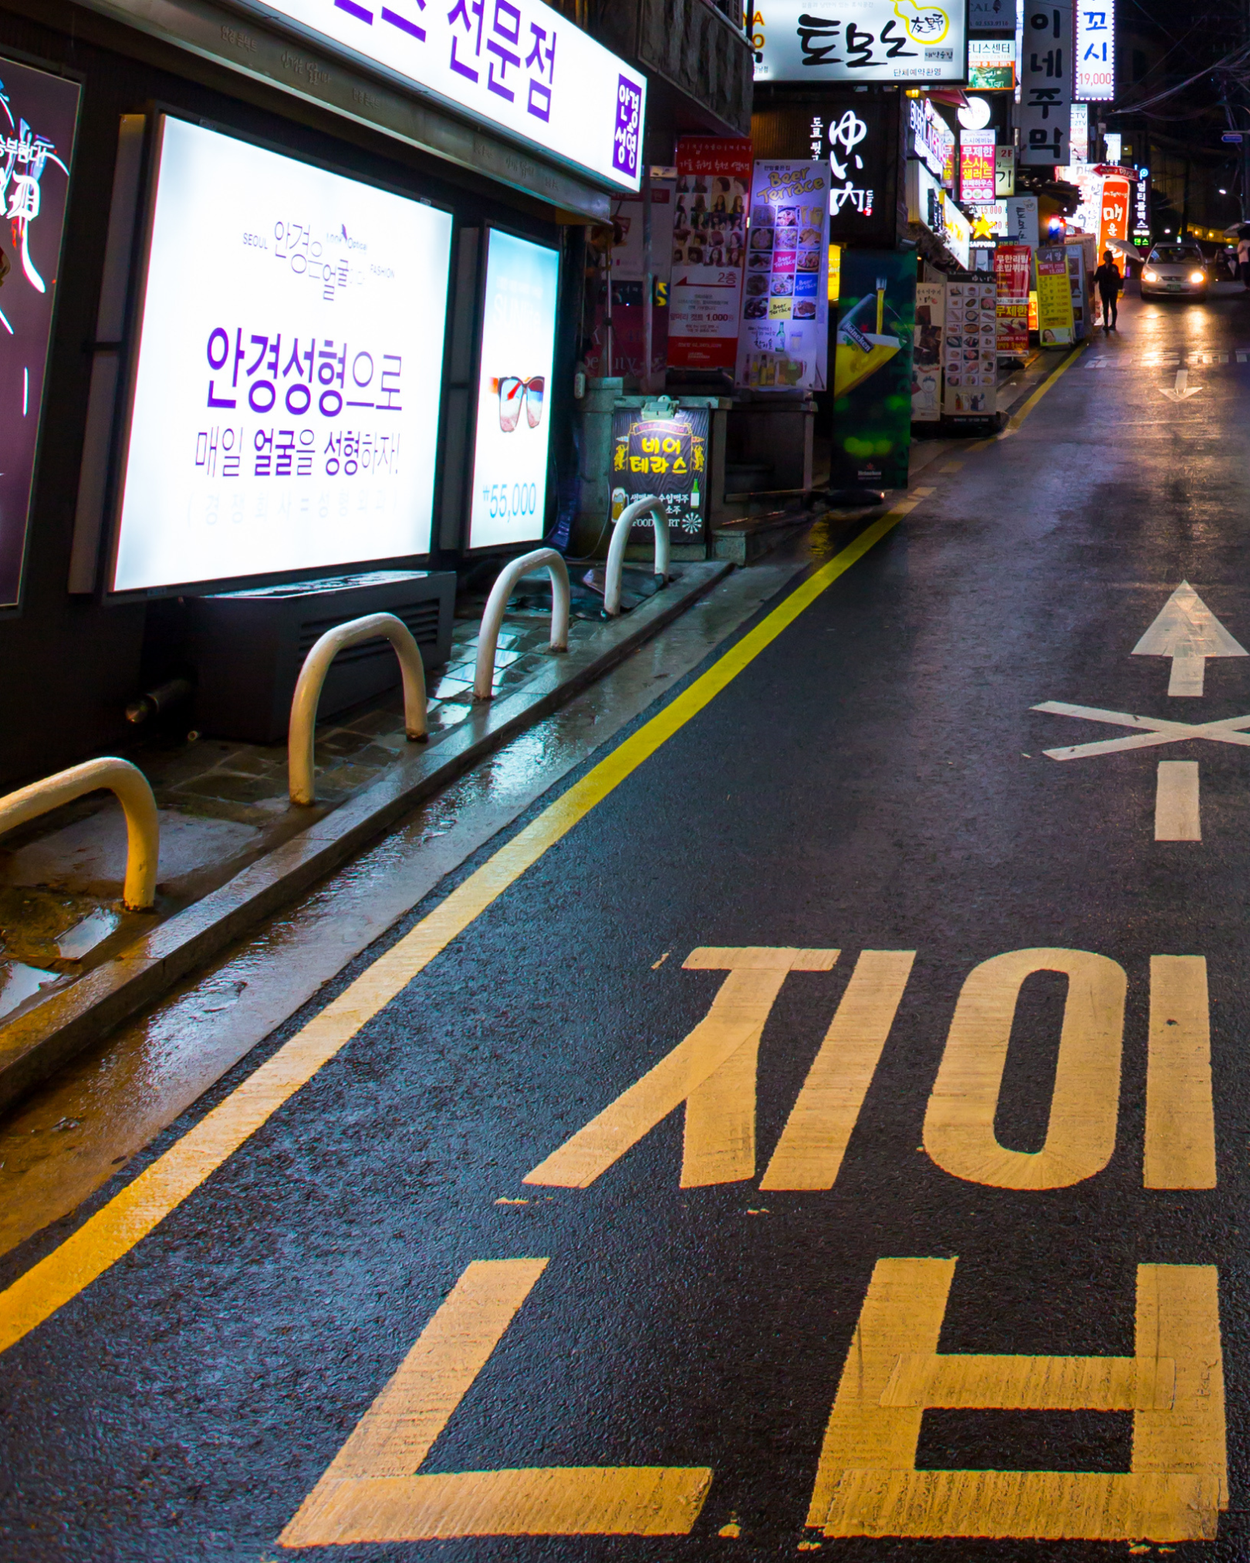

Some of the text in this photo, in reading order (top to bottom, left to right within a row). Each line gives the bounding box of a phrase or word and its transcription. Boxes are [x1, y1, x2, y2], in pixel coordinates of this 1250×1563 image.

[1078, 72, 1112, 86] 19,000
[961, 146, 994, 158] 무제한
[1000, 149, 1013, 157] 2F
[769, 166, 810, 188] Beer
[756, 176, 825, 204] Terrace
[242, 232, 268, 250] SEOUL
[969, 241, 996, 249] SAPPORO
[369, 263, 395, 280] FASHION
[717, 271, 738, 285] 2층
[995, 304, 1028, 318] 무제한
[843, 322, 875, 354] Heineken
[206, 326, 403, 418] 안경성형으로
[195, 425, 401, 478] 매일 얼굴을 성형하자!
[641, 437, 682, 455] 비어
[629, 456, 688, 474] 테라스
[665, 505, 682, 515] 소주
